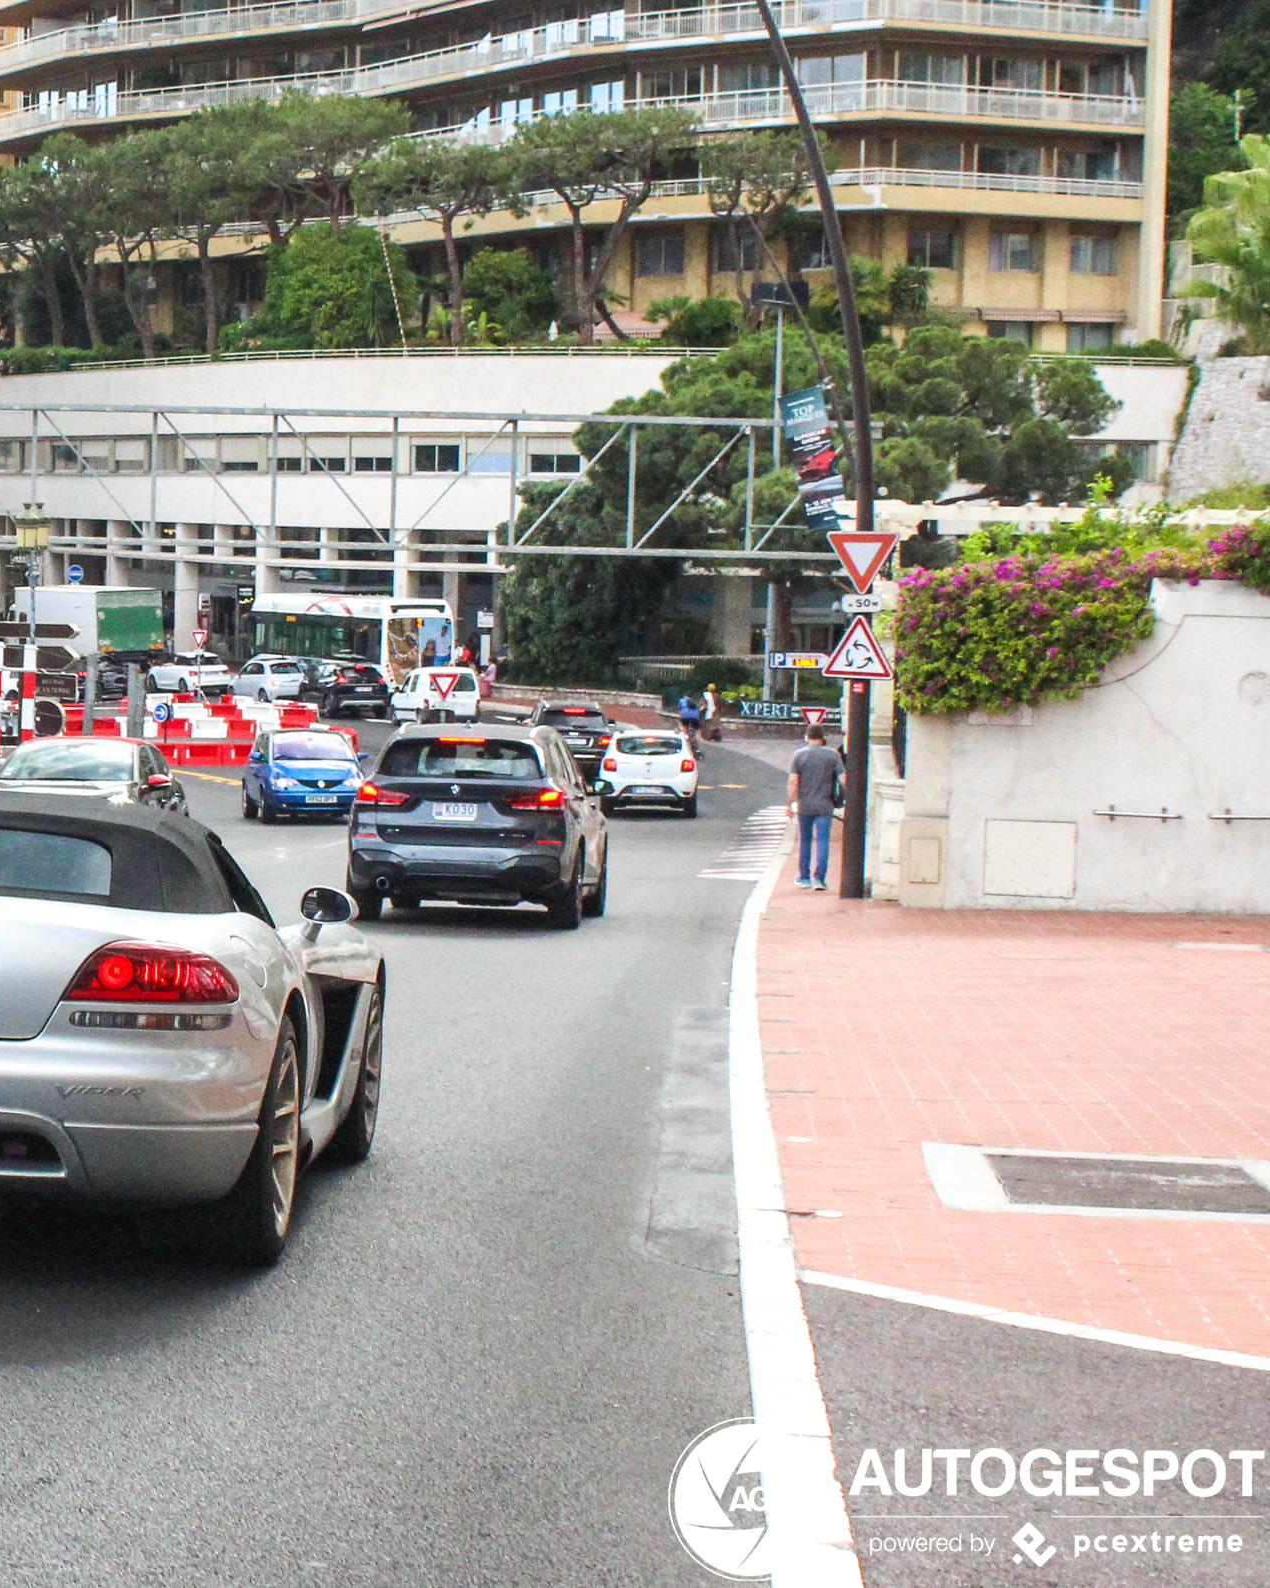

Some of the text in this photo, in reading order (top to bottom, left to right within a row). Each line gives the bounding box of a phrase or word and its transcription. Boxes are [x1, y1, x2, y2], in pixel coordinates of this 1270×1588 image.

[791, 404, 815, 418] TOP
[445, 803, 475, 815] K030
[55, 1083, 144, 1100] VIPER
